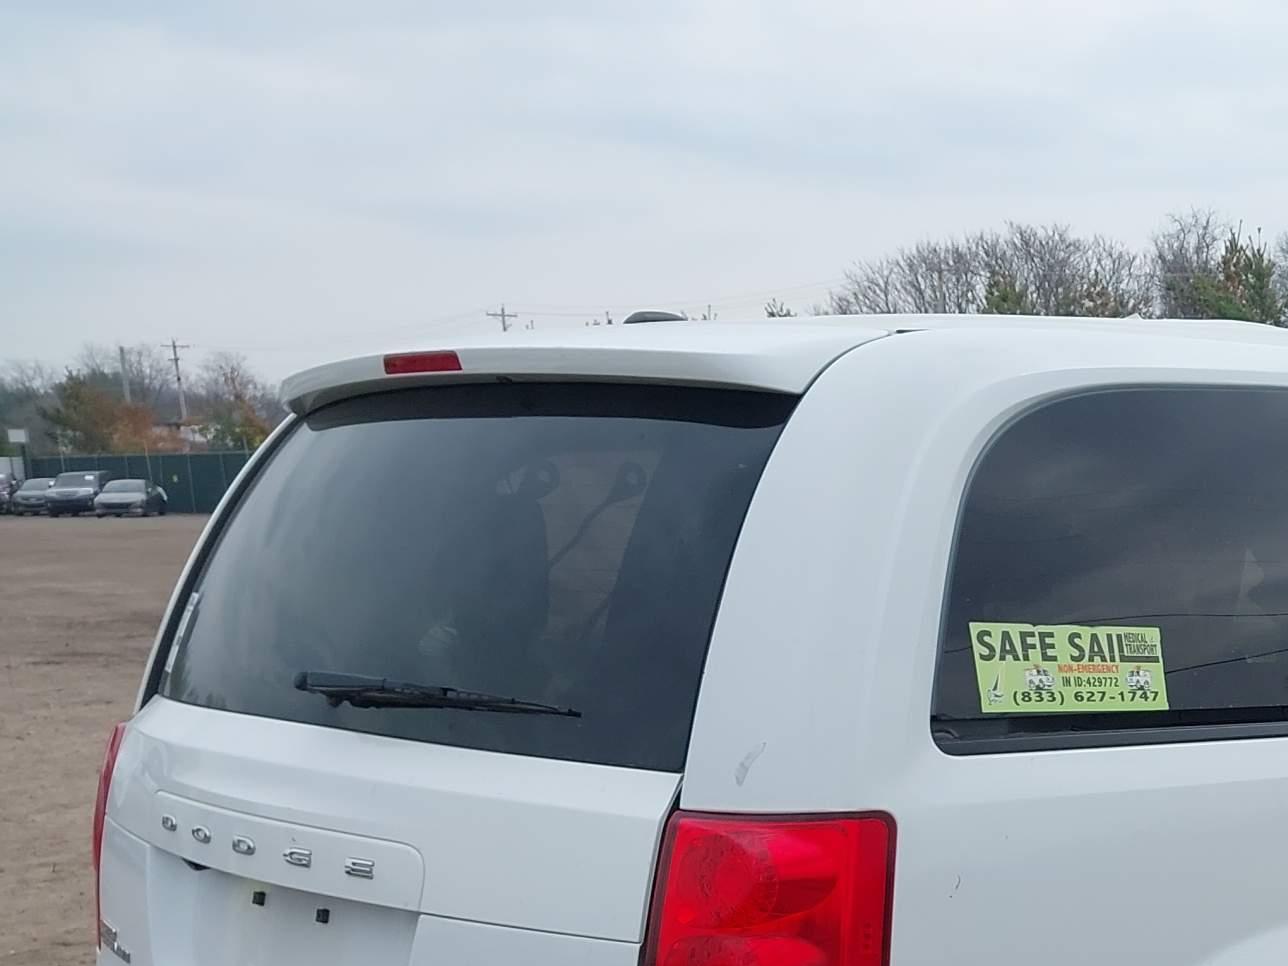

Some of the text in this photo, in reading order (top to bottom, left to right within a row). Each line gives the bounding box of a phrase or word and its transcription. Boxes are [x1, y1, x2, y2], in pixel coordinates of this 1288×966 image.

[1124, 631, 1148, 643] MEDICAL
[976, 629, 1160, 663] SAFE SAIL
[1125, 643, 1157, 656] TRANSPORT
[1057, 664, 1119, 673] NON-EMERGENCY
[1062, 676, 1119, 688] IN ID:429772
[1013, 690, 1159, 705] (833) 627-1747
[161, 814, 375, 880] DODGE
